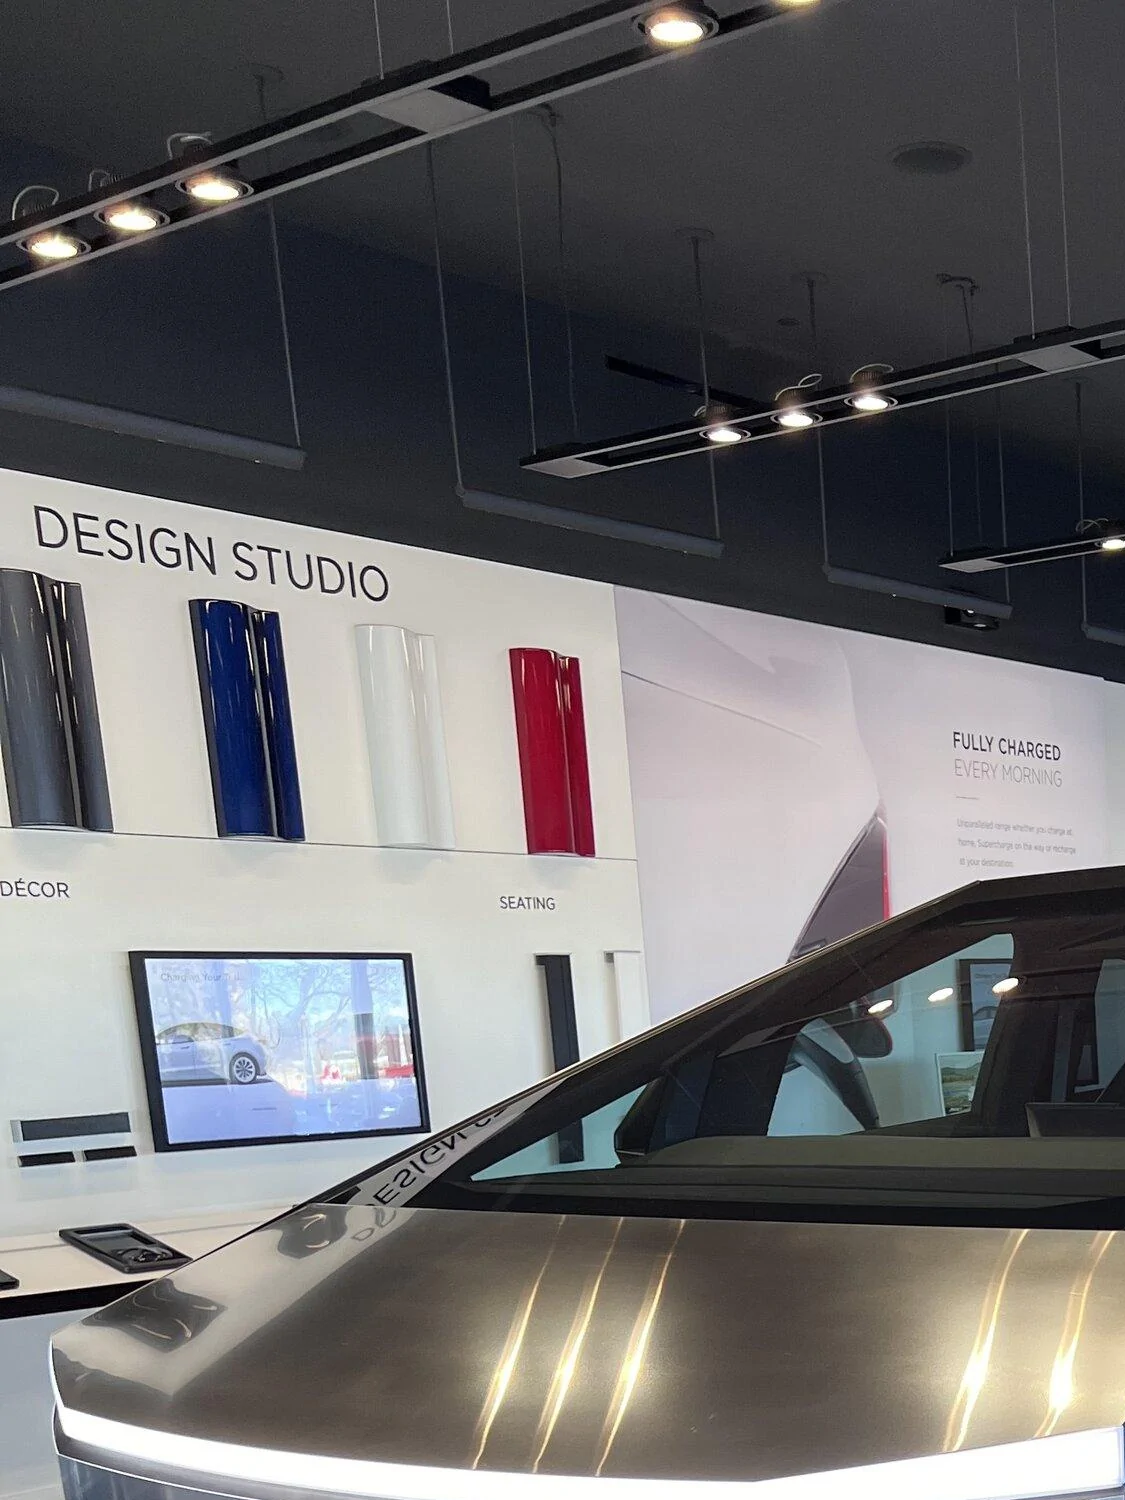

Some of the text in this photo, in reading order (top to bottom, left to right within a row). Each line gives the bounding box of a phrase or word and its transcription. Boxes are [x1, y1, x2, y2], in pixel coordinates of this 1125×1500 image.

[34, 505, 389, 602] DESIGN STUDIO
[953, 731, 1061, 761] FULLY CHARGED
[954, 758, 1063, 788] EVERY MORNING
[0, 877, 71, 899] DÉCOR
[500, 896, 556, 911] SEATING
